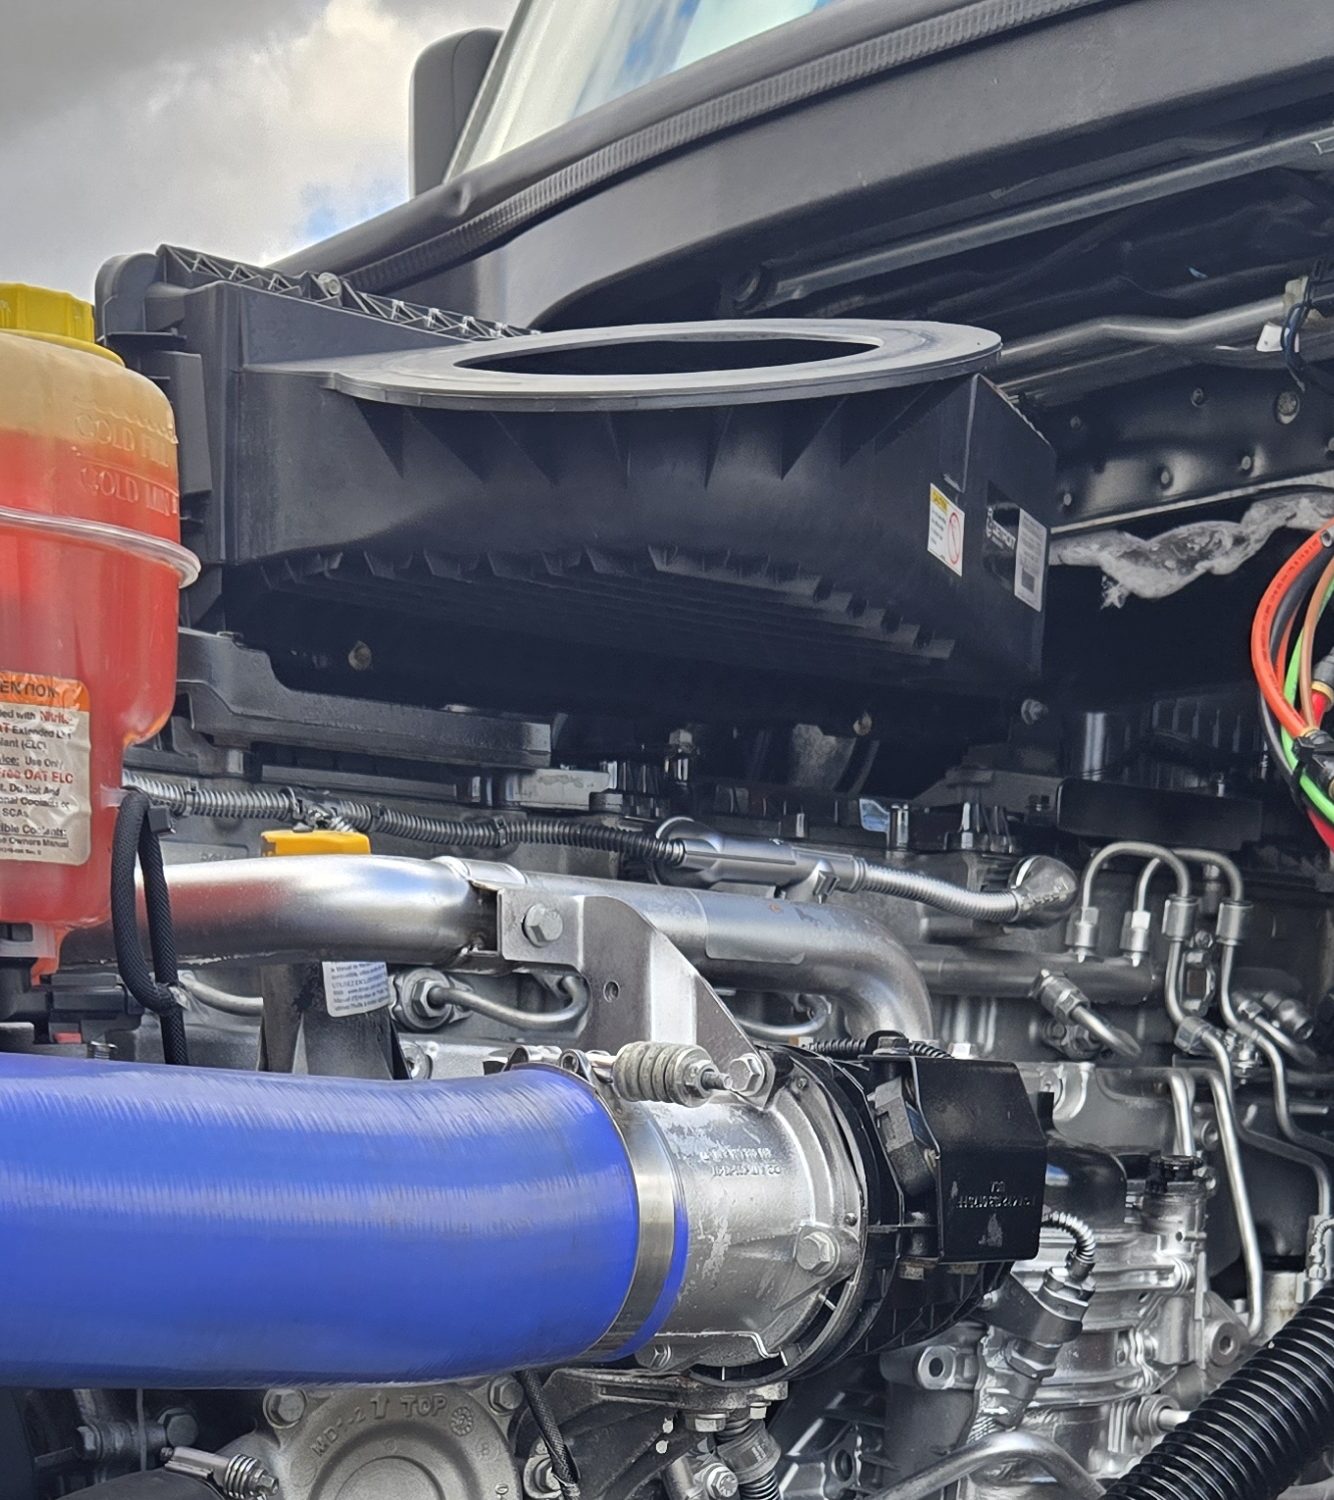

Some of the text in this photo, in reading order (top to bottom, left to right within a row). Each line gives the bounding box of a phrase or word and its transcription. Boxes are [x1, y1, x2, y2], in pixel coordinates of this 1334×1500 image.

[16, 711, 36, 720] with
[12, 725, 55, 738] Extended
[25, 757, 42, 766] Use
[44, 757, 63, 770] Only
[24, 769, 48, 781] OAT
[52, 773, 74, 784] ELC
[9, 784, 24, 793] Do
[25, 785, 42, 794] Not
[2, 807, 29, 818] SCAs
[22, 824, 67, 837] Coolants:
[9, 837, 42, 847] Owners
[43, 839, 70, 849] Manual
[400, 1395, 447, 1418] TOP
